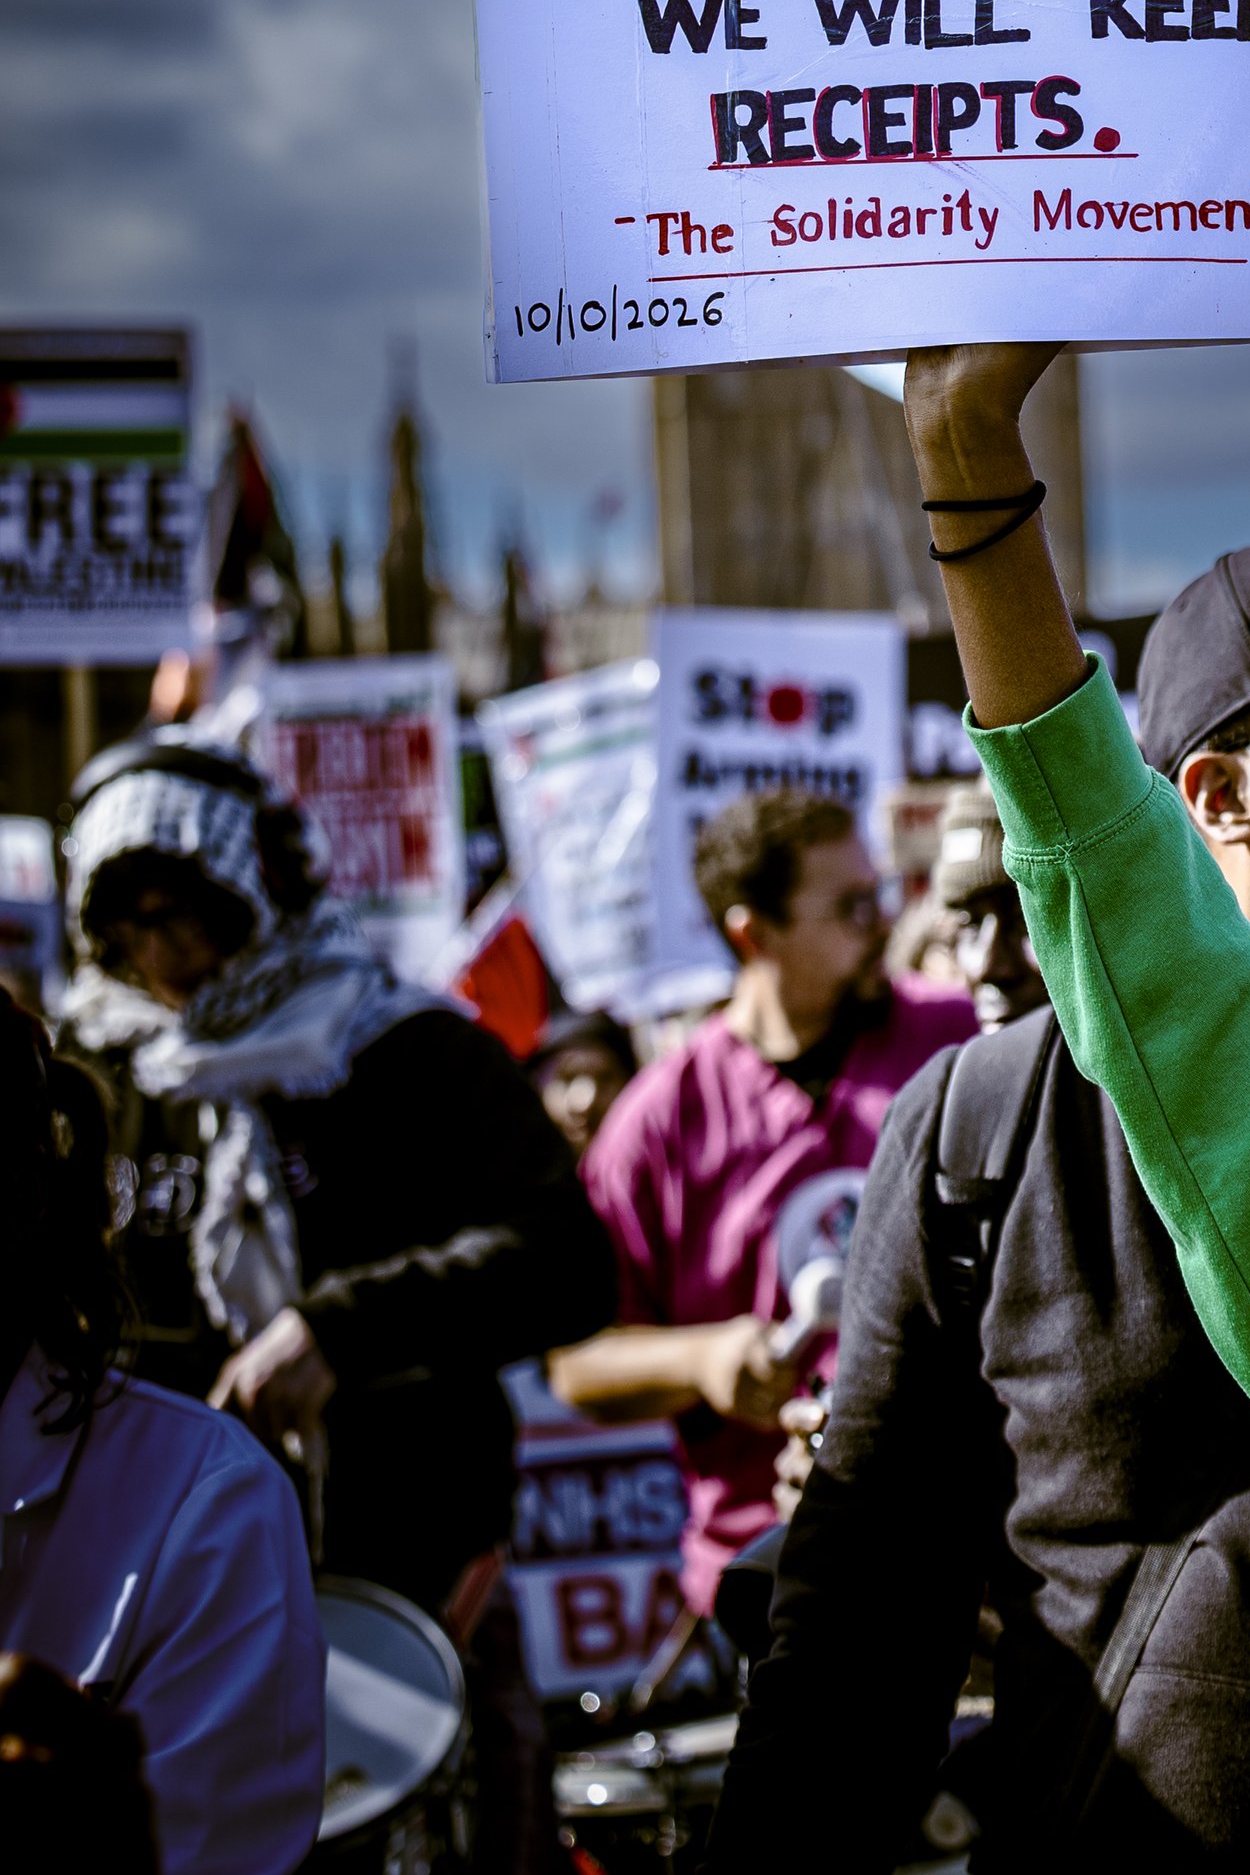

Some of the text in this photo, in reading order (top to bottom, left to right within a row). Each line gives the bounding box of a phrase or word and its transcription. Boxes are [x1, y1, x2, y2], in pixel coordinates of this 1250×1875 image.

[710, 76, 1121, 165] RECEIPTS.
[768, 189, 998, 249] Solidarity
[515, 284, 724, 346] 10/10/2026
[512, 1463, 684, 1553] NHS
